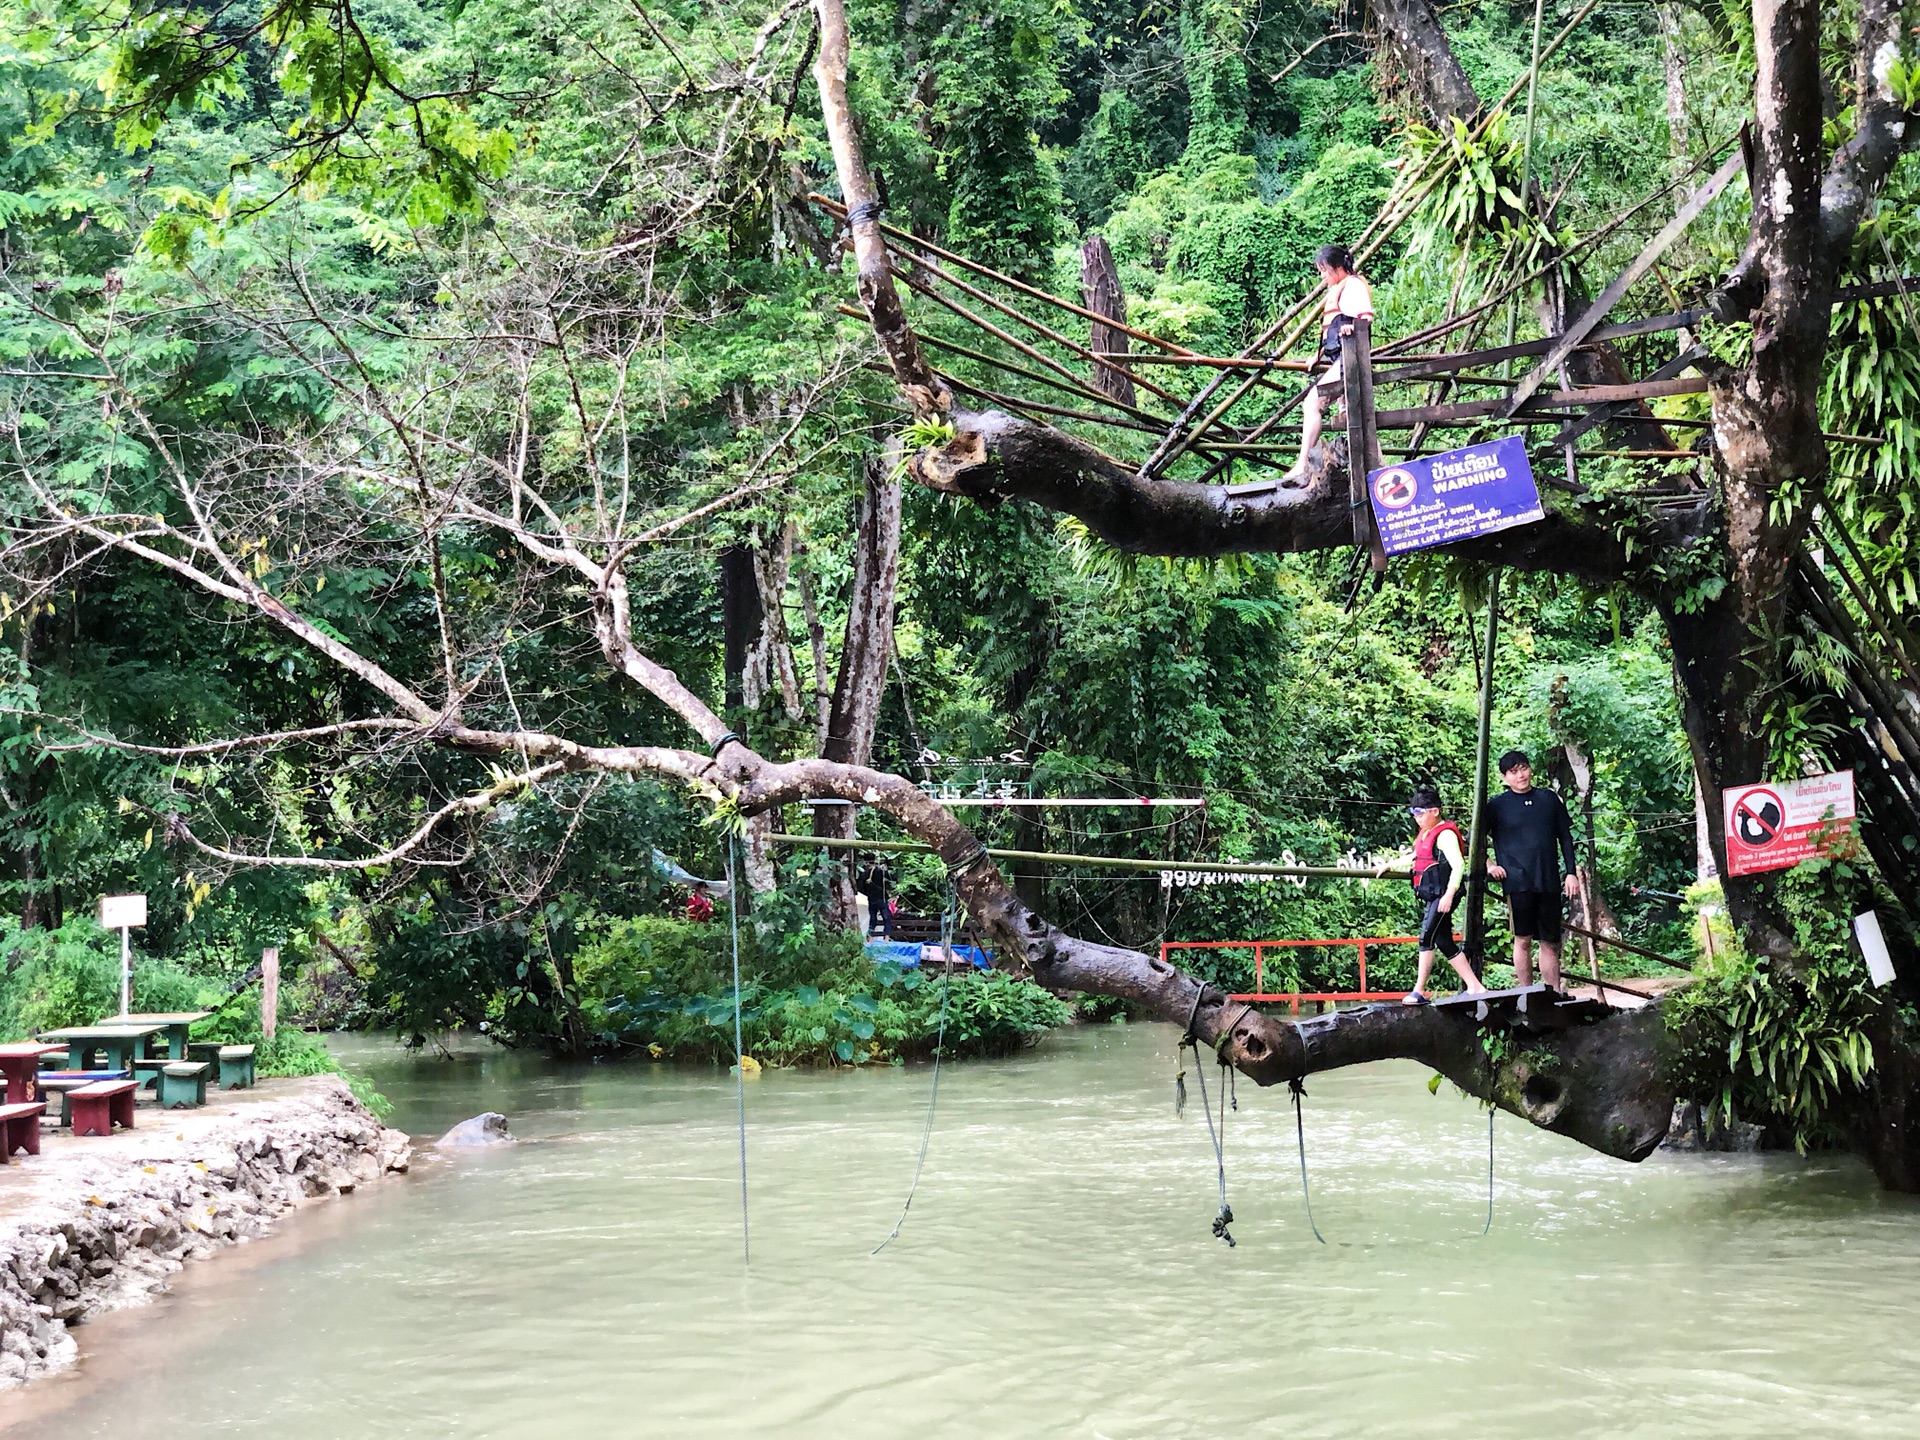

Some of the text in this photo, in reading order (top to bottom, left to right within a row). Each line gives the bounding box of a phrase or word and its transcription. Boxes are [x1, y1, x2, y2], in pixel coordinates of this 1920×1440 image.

[1433, 468, 1506, 493] WARNING
[1422, 510, 1447, 522] DON'T
[1450, 504, 1474, 514] SWIM
[1393, 539, 1419, 550] WEAR
[1421, 534, 1440, 543] LIFE
[1443, 525, 1476, 538] JACKET
[1479, 516, 1514, 529] BEFORE
[1784, 833, 1792, 841] Get
[1793, 831, 1806, 840] drunk
